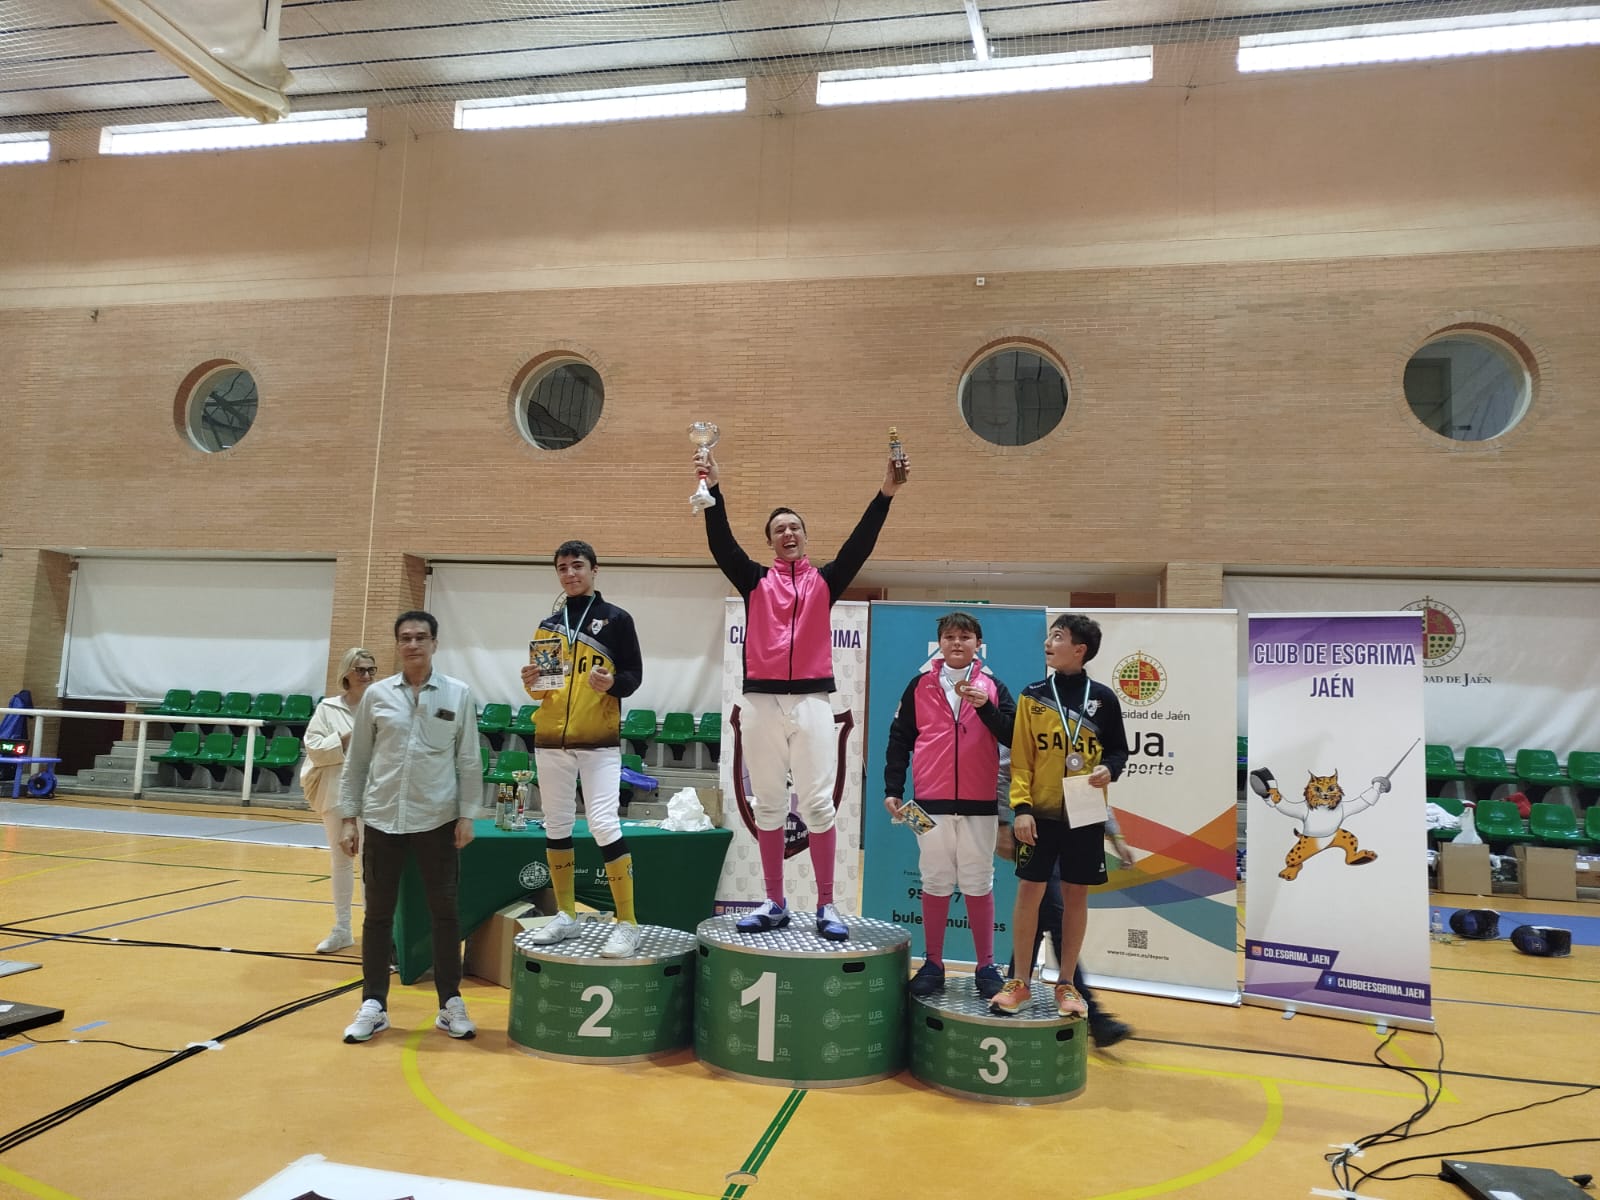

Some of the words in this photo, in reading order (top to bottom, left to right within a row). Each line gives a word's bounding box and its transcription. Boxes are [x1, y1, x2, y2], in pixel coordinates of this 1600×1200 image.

[730, 626, 745, 645] CL
[1254, 644, 1298, 664] CLUB
[1303, 644, 1326, 664] DE
[1333, 643, 1416, 666] ESGRIMA
[1310, 673, 1354, 698] JAÉN
[1121, 710, 1148, 720] sidad
[1151, 710, 1163, 720] de
[1165, 711, 1191, 721] Jaén
[893, 909, 923, 925] bule
[1263, 947, 1330, 965] CD.ESGRIMA_JAEN
[577, 985, 614, 1037] 2
[741, 971, 776, 1062] 1
[978, 1037, 1008, 1084] 3
